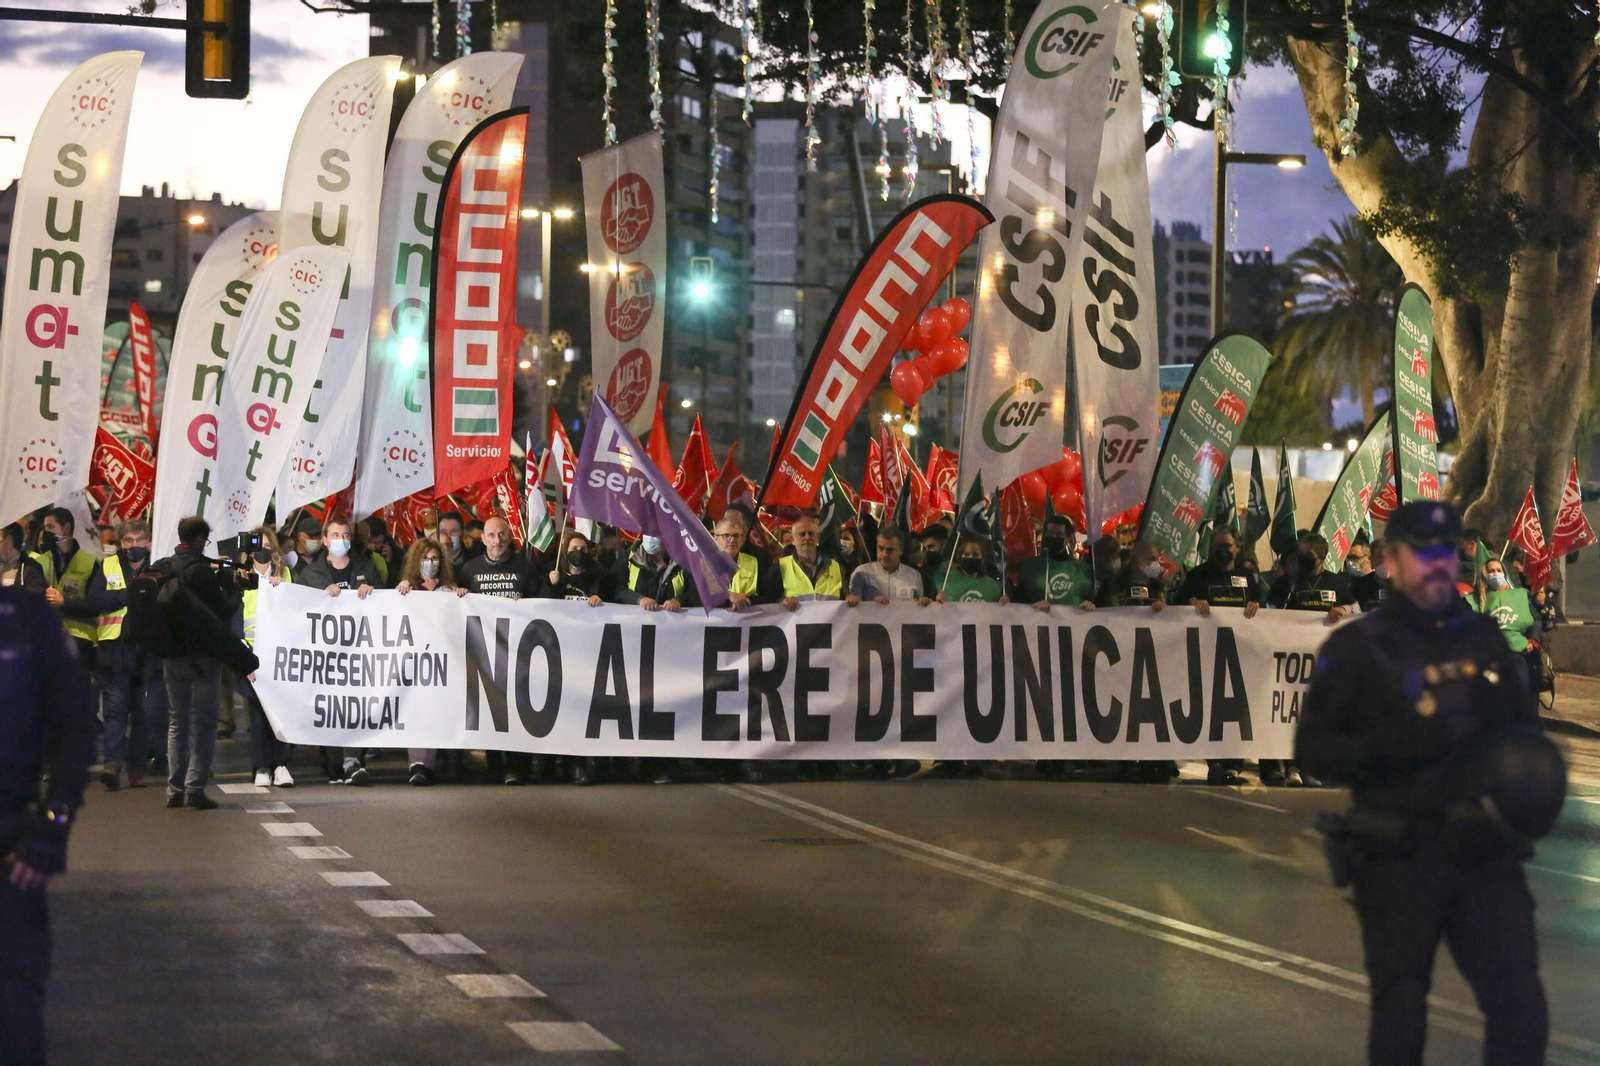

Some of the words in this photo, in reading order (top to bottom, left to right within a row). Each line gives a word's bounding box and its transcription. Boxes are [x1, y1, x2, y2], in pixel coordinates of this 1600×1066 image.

[1041, 27, 1105, 57] CSIF
[79, 95, 109, 112] CIC
[337, 100, 368, 117] CIC
[449, 92, 484, 111] CIC
[611, 181, 641, 219] UGT
[994, 129, 1078, 333] CSIF
[294, 269, 318, 285] CIC
[455, 153, 508, 381] CCOO
[1082, 191, 1142, 371] CSIF
[616, 356, 644, 395] UGT
[1212, 348, 1251, 391] CESICA
[1200, 376, 1219, 398] cesica
[1399, 370, 1432, 404] CESICA
[100, 410, 140, 425] CCOO
[1000, 401, 1051, 427] CSIF
[1191, 398, 1232, 443] CESICA
[389, 447, 419, 464] CIC
[446, 445, 502, 459] Servicios
[1179, 428, 1199, 451] cesica
[1400, 432, 1437, 464] CESICA
[27, 456, 58, 472] CIC
[102, 448, 134, 492] UGT
[1171, 453, 1211, 497] CESICA
[232, 500, 249, 516] CIC
[477, 573, 517, 581] UNICAJA
[1052, 580, 1074, 590] CSIF
[306, 612, 374, 648] TODA
[382, 614, 414, 647] LA
[274, 644, 448, 688] REPRESENTACIÓN
[465, 615, 562, 739] NO
[585, 623, 675, 741] AL
[701, 623, 832, 742] ERE
[854, 623, 937, 742] DE
[962, 623, 1253, 744] UNICAJA
[1273, 652, 1316, 684] TOD
[313, 693, 405, 731] SINDICAL
